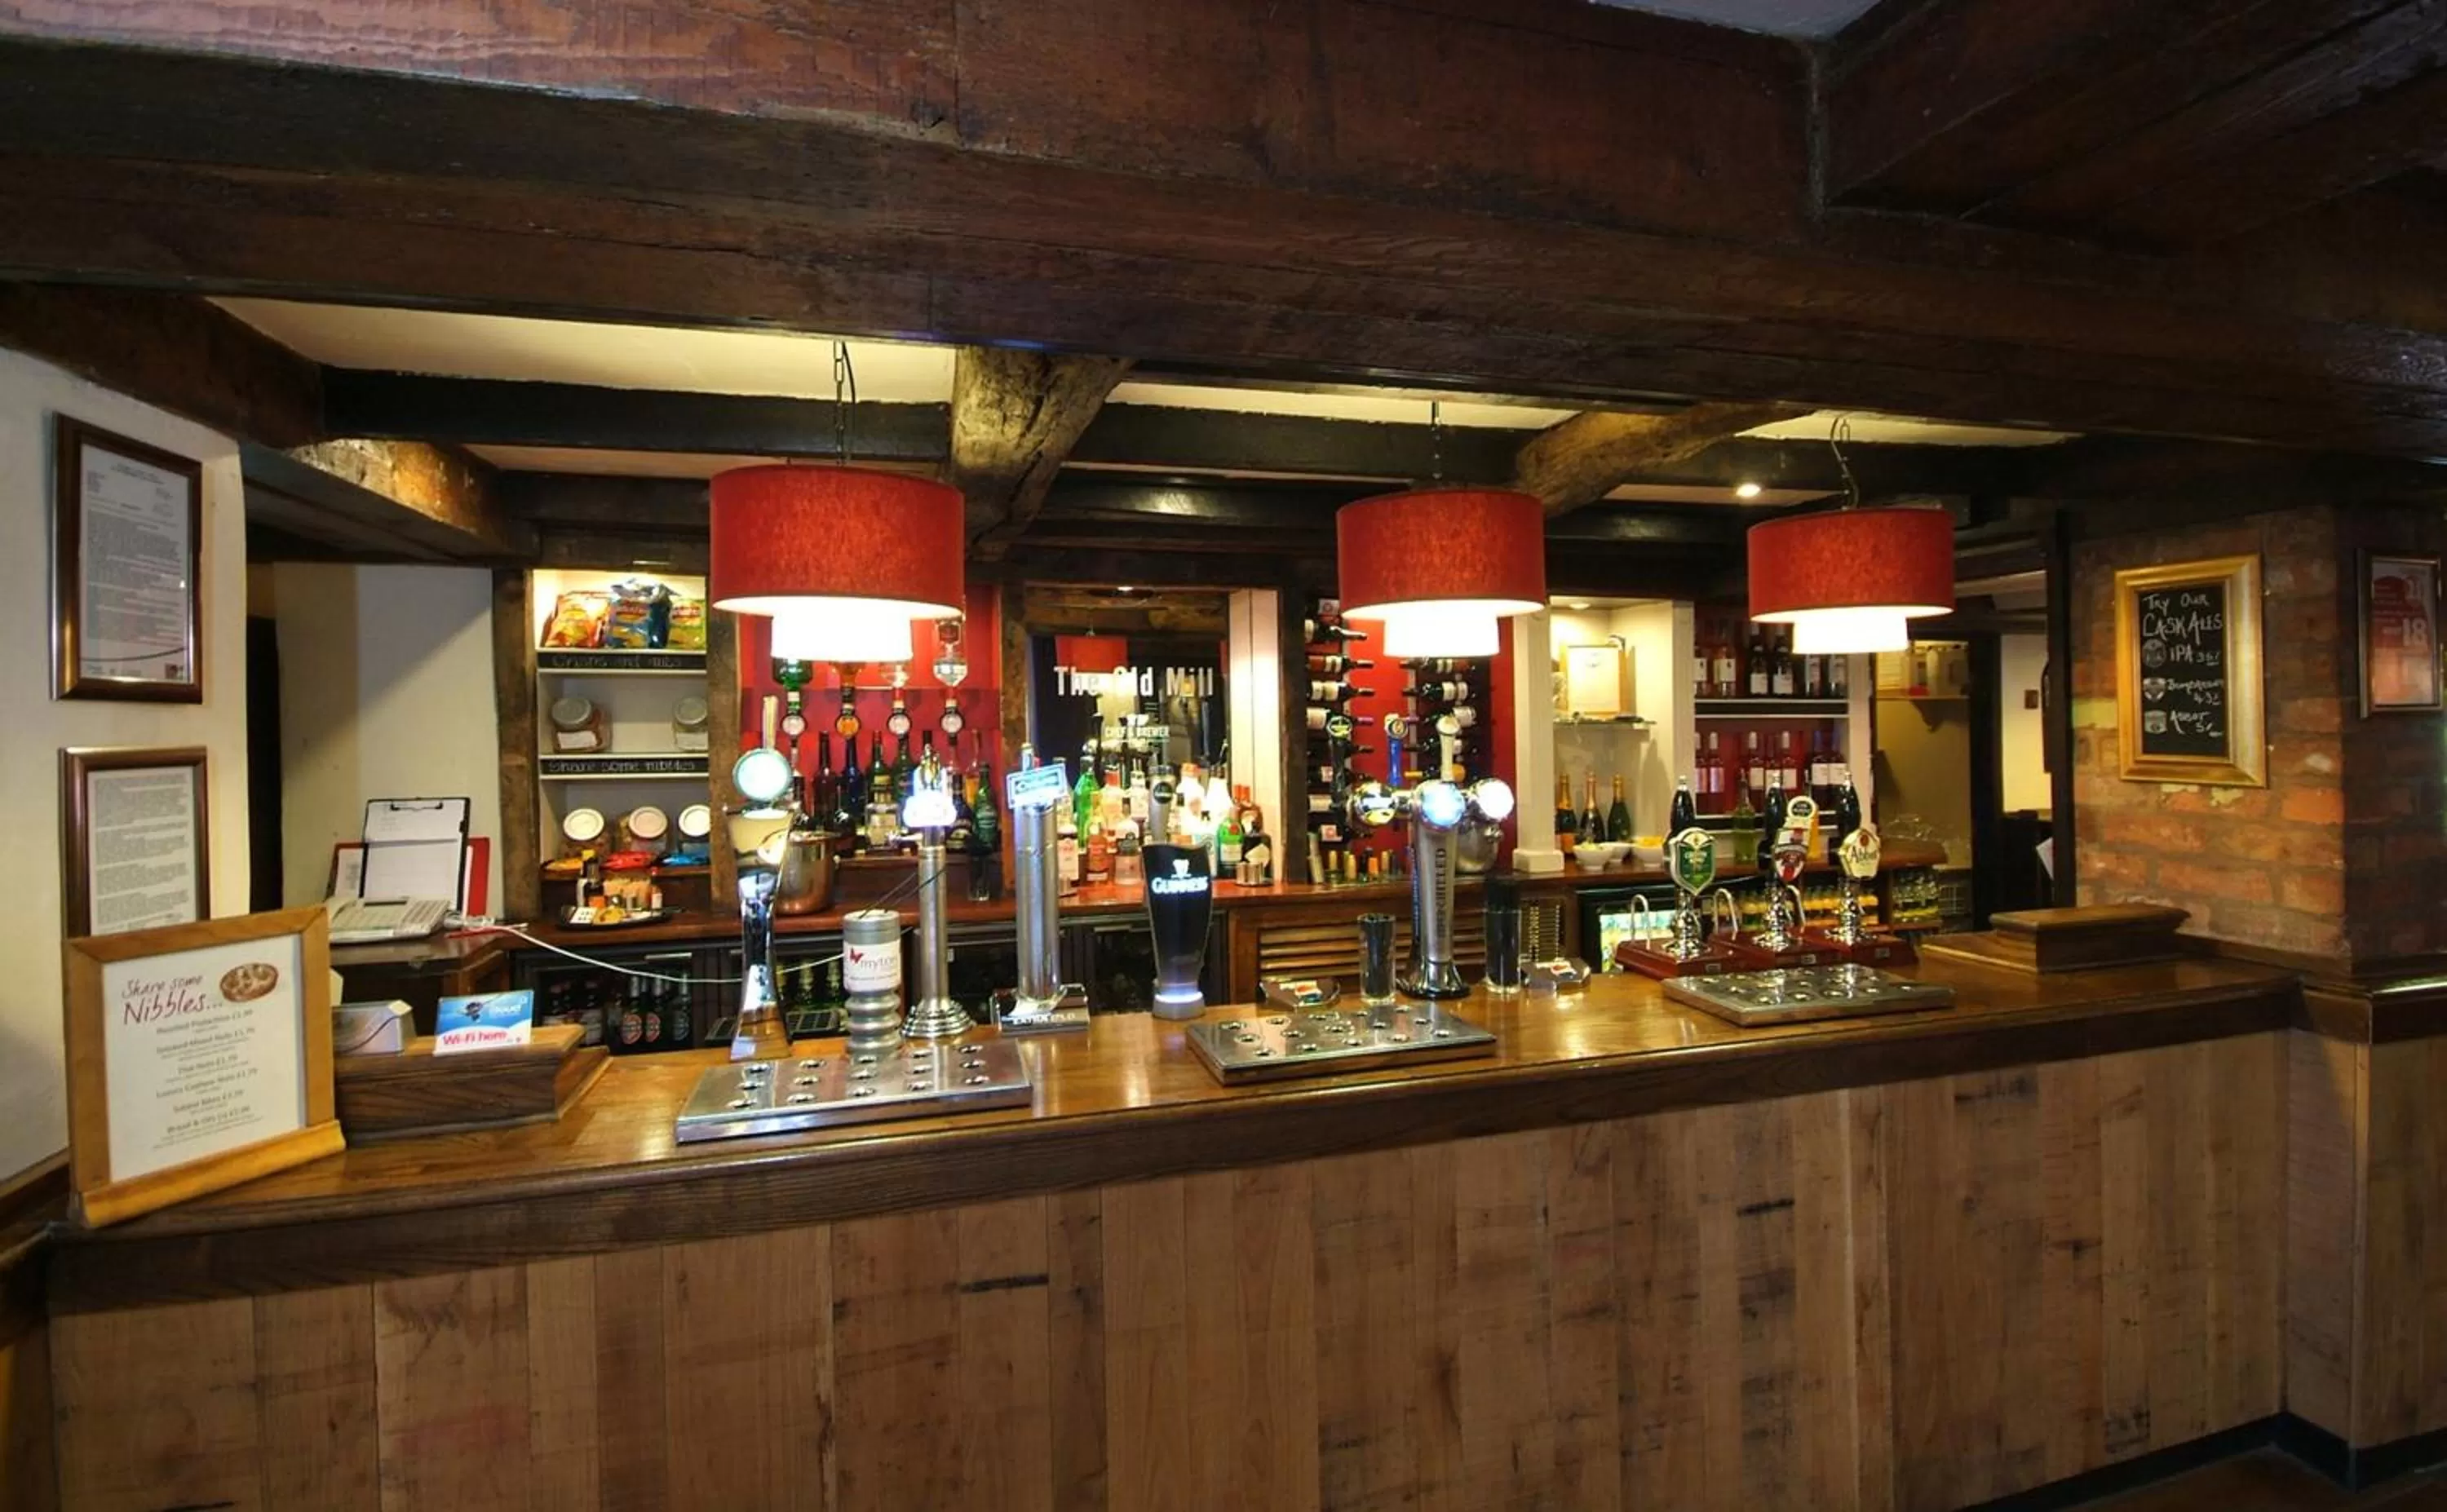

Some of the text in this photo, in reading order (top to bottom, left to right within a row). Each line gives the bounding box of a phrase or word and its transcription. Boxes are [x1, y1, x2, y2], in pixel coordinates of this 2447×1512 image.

[2403, 617, 2428, 648] 18
[2170, 643, 2193, 663] IPA
[1054, 665, 1214, 696] The Old Mill
[1151, 876, 1209, 895] GUINNESS
